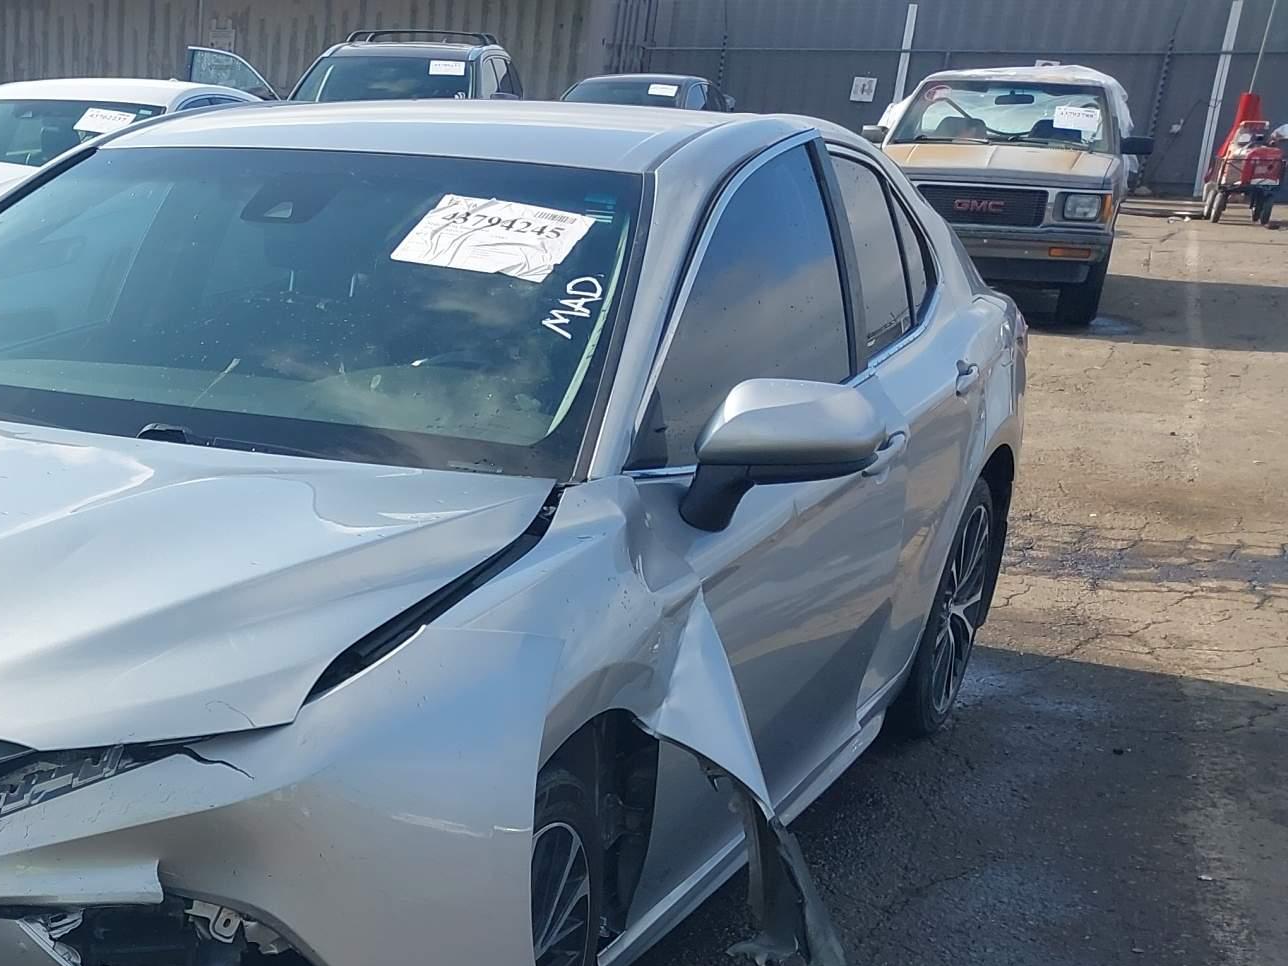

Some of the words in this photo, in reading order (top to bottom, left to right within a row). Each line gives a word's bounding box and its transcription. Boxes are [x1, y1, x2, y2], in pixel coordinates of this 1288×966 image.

[953, 199, 1005, 213] GMC
[442, 211, 565, 240] 43794245
[542, 276, 603, 340] MAD
